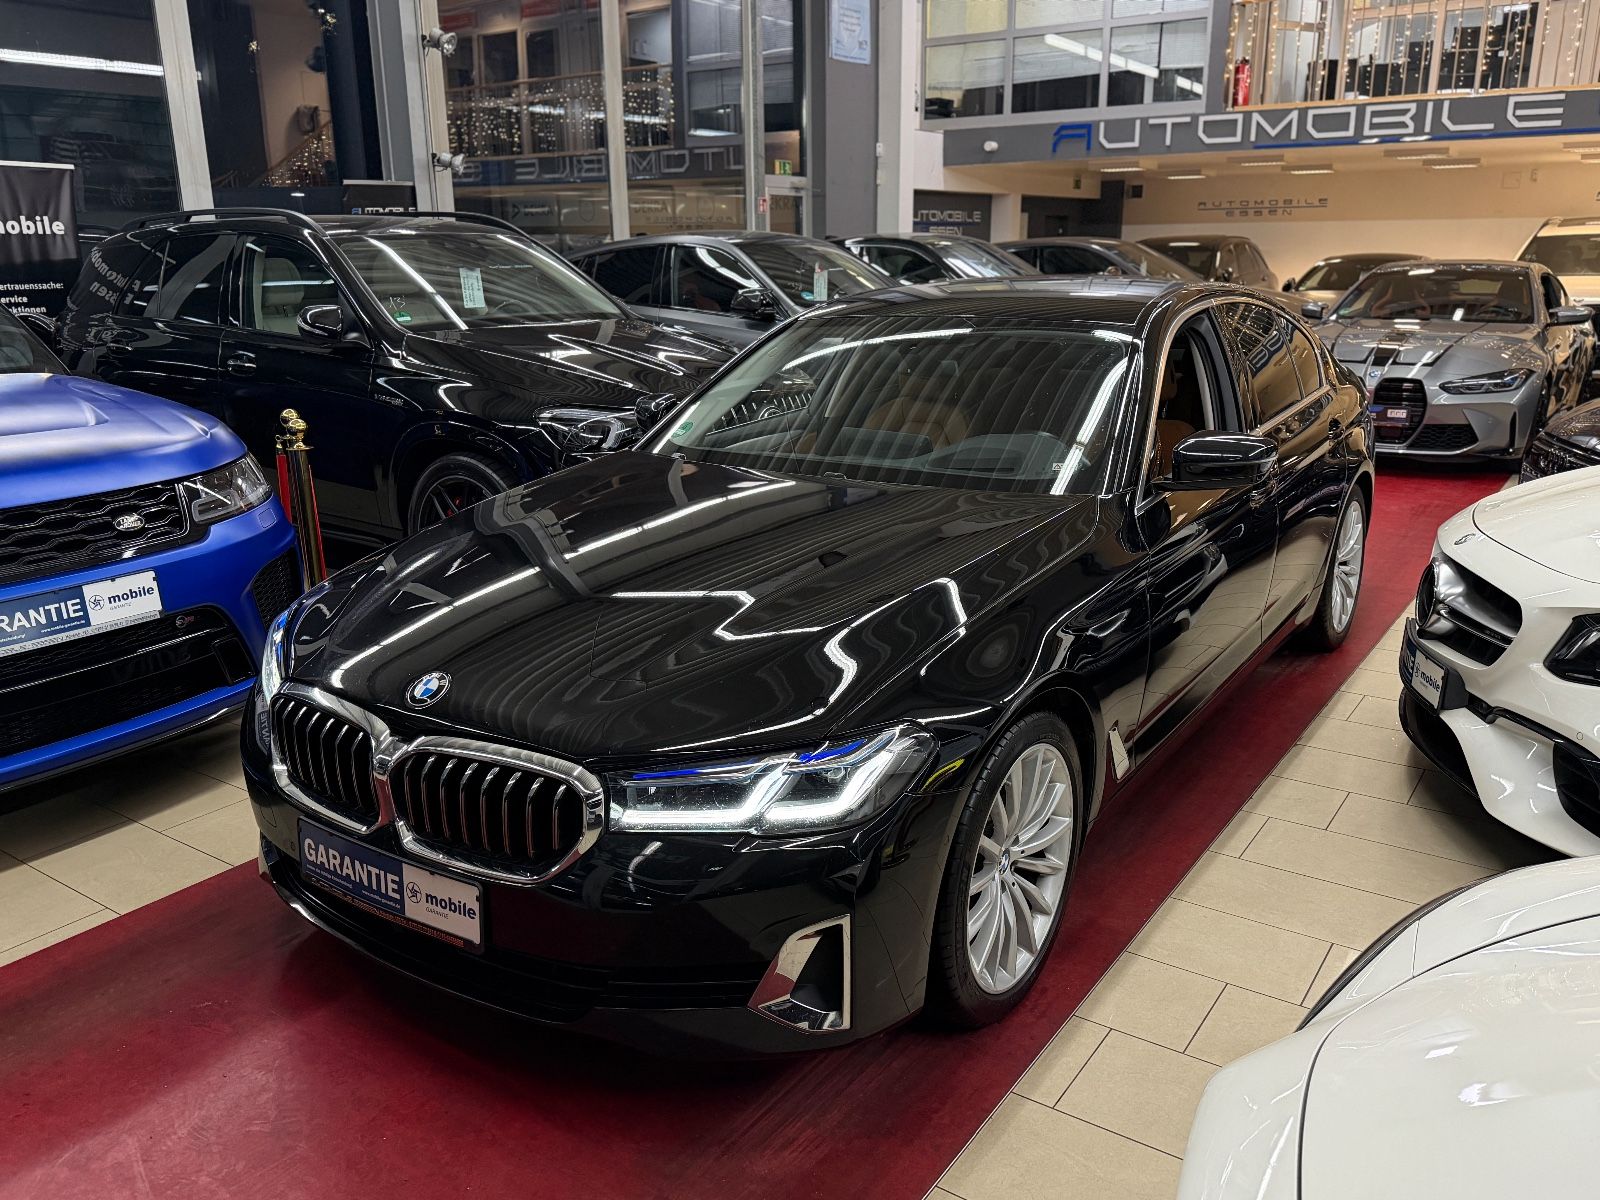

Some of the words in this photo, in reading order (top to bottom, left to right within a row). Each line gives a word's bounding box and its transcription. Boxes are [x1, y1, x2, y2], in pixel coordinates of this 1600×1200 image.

[1053, 93, 1567, 153] AUTOMOBILE
[1197, 198, 1329, 208] AUTOMOBILE
[1225, 209, 1293, 217] ESSEN
[0, 215, 65, 235] obile
[107, 585, 155, 605] mobile
[1420, 670, 1440, 693] mobile
[303, 837, 401, 900] GARANTIE
[425, 890, 477, 920] mobile
